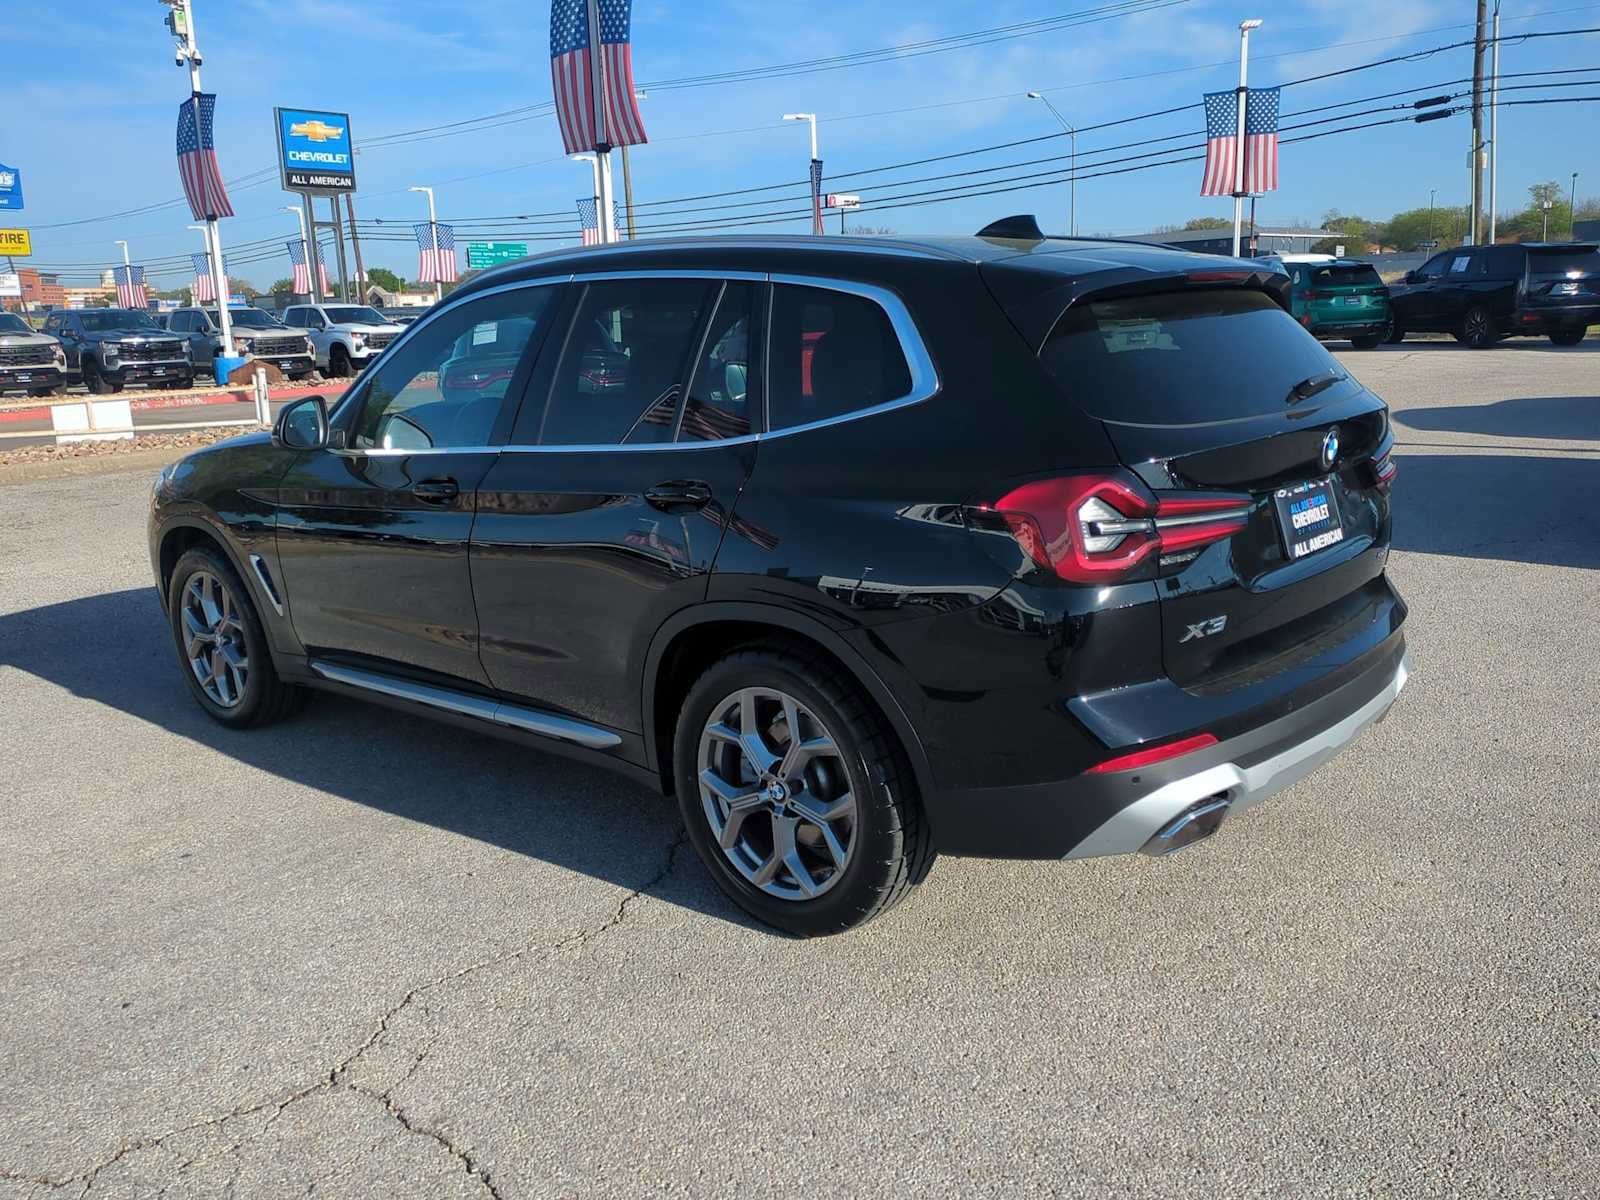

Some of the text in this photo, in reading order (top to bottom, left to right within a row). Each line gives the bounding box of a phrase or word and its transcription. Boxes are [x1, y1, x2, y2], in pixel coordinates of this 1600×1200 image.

[288, 151, 348, 164] CHEVROLET
[291, 175, 352, 187] ALL AMERICAN
[1292, 503, 1330, 529] CHEVROLET
[1295, 541, 1310, 557] ALL
[1309, 527, 1343, 552] AMERICAN
[1179, 614, 1228, 643] X3
